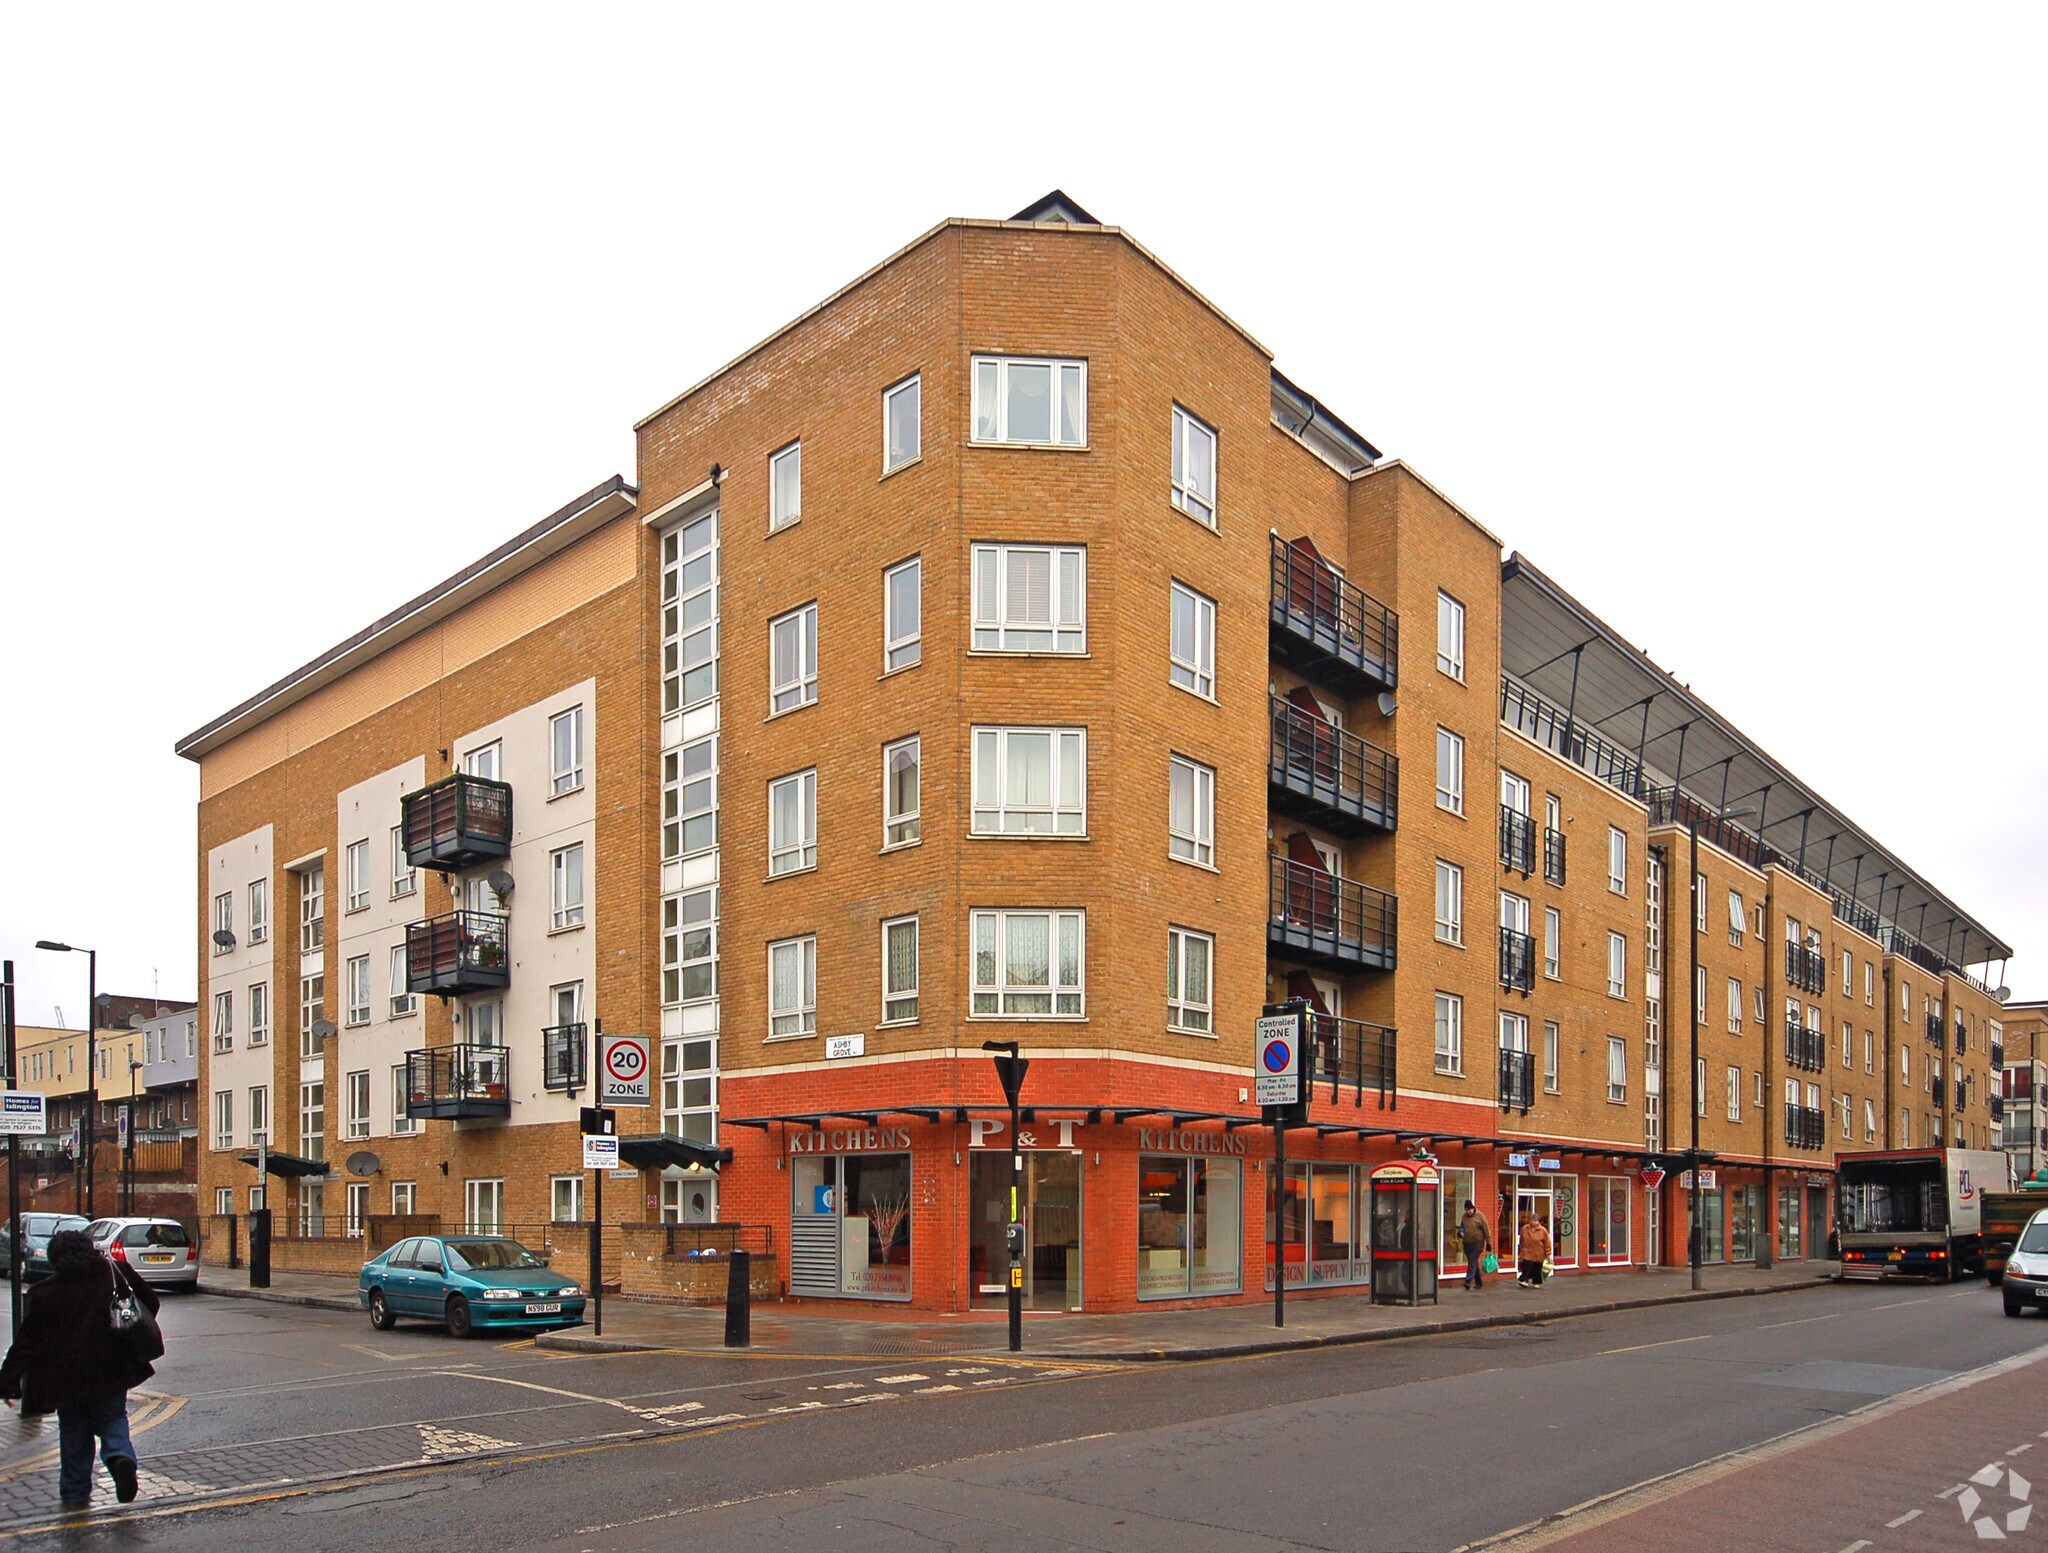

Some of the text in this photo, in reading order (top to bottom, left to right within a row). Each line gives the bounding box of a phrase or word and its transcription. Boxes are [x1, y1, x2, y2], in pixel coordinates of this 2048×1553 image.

[1258, 1018, 1296, 1028] Controlled
[1263, 1028, 1290, 1038] ZONE
[832, 1048, 851, 1057] GROVE
[833, 1040, 852, 1049] ASHBY
[613, 1051, 640, 1069] 20
[609, 1084, 644, 1094] ZONE
[790, 1127, 911, 1153] KITCHENS
[968, 1119, 1084, 1147] P & T
[1140, 1128, 1246, 1154] KITCHENS
[1959, 1169, 1972, 1193] PCL
[1267, 1266, 1305, 1283] DSIGN
[1312, 1263, 1347, 1280] SUPPLY
